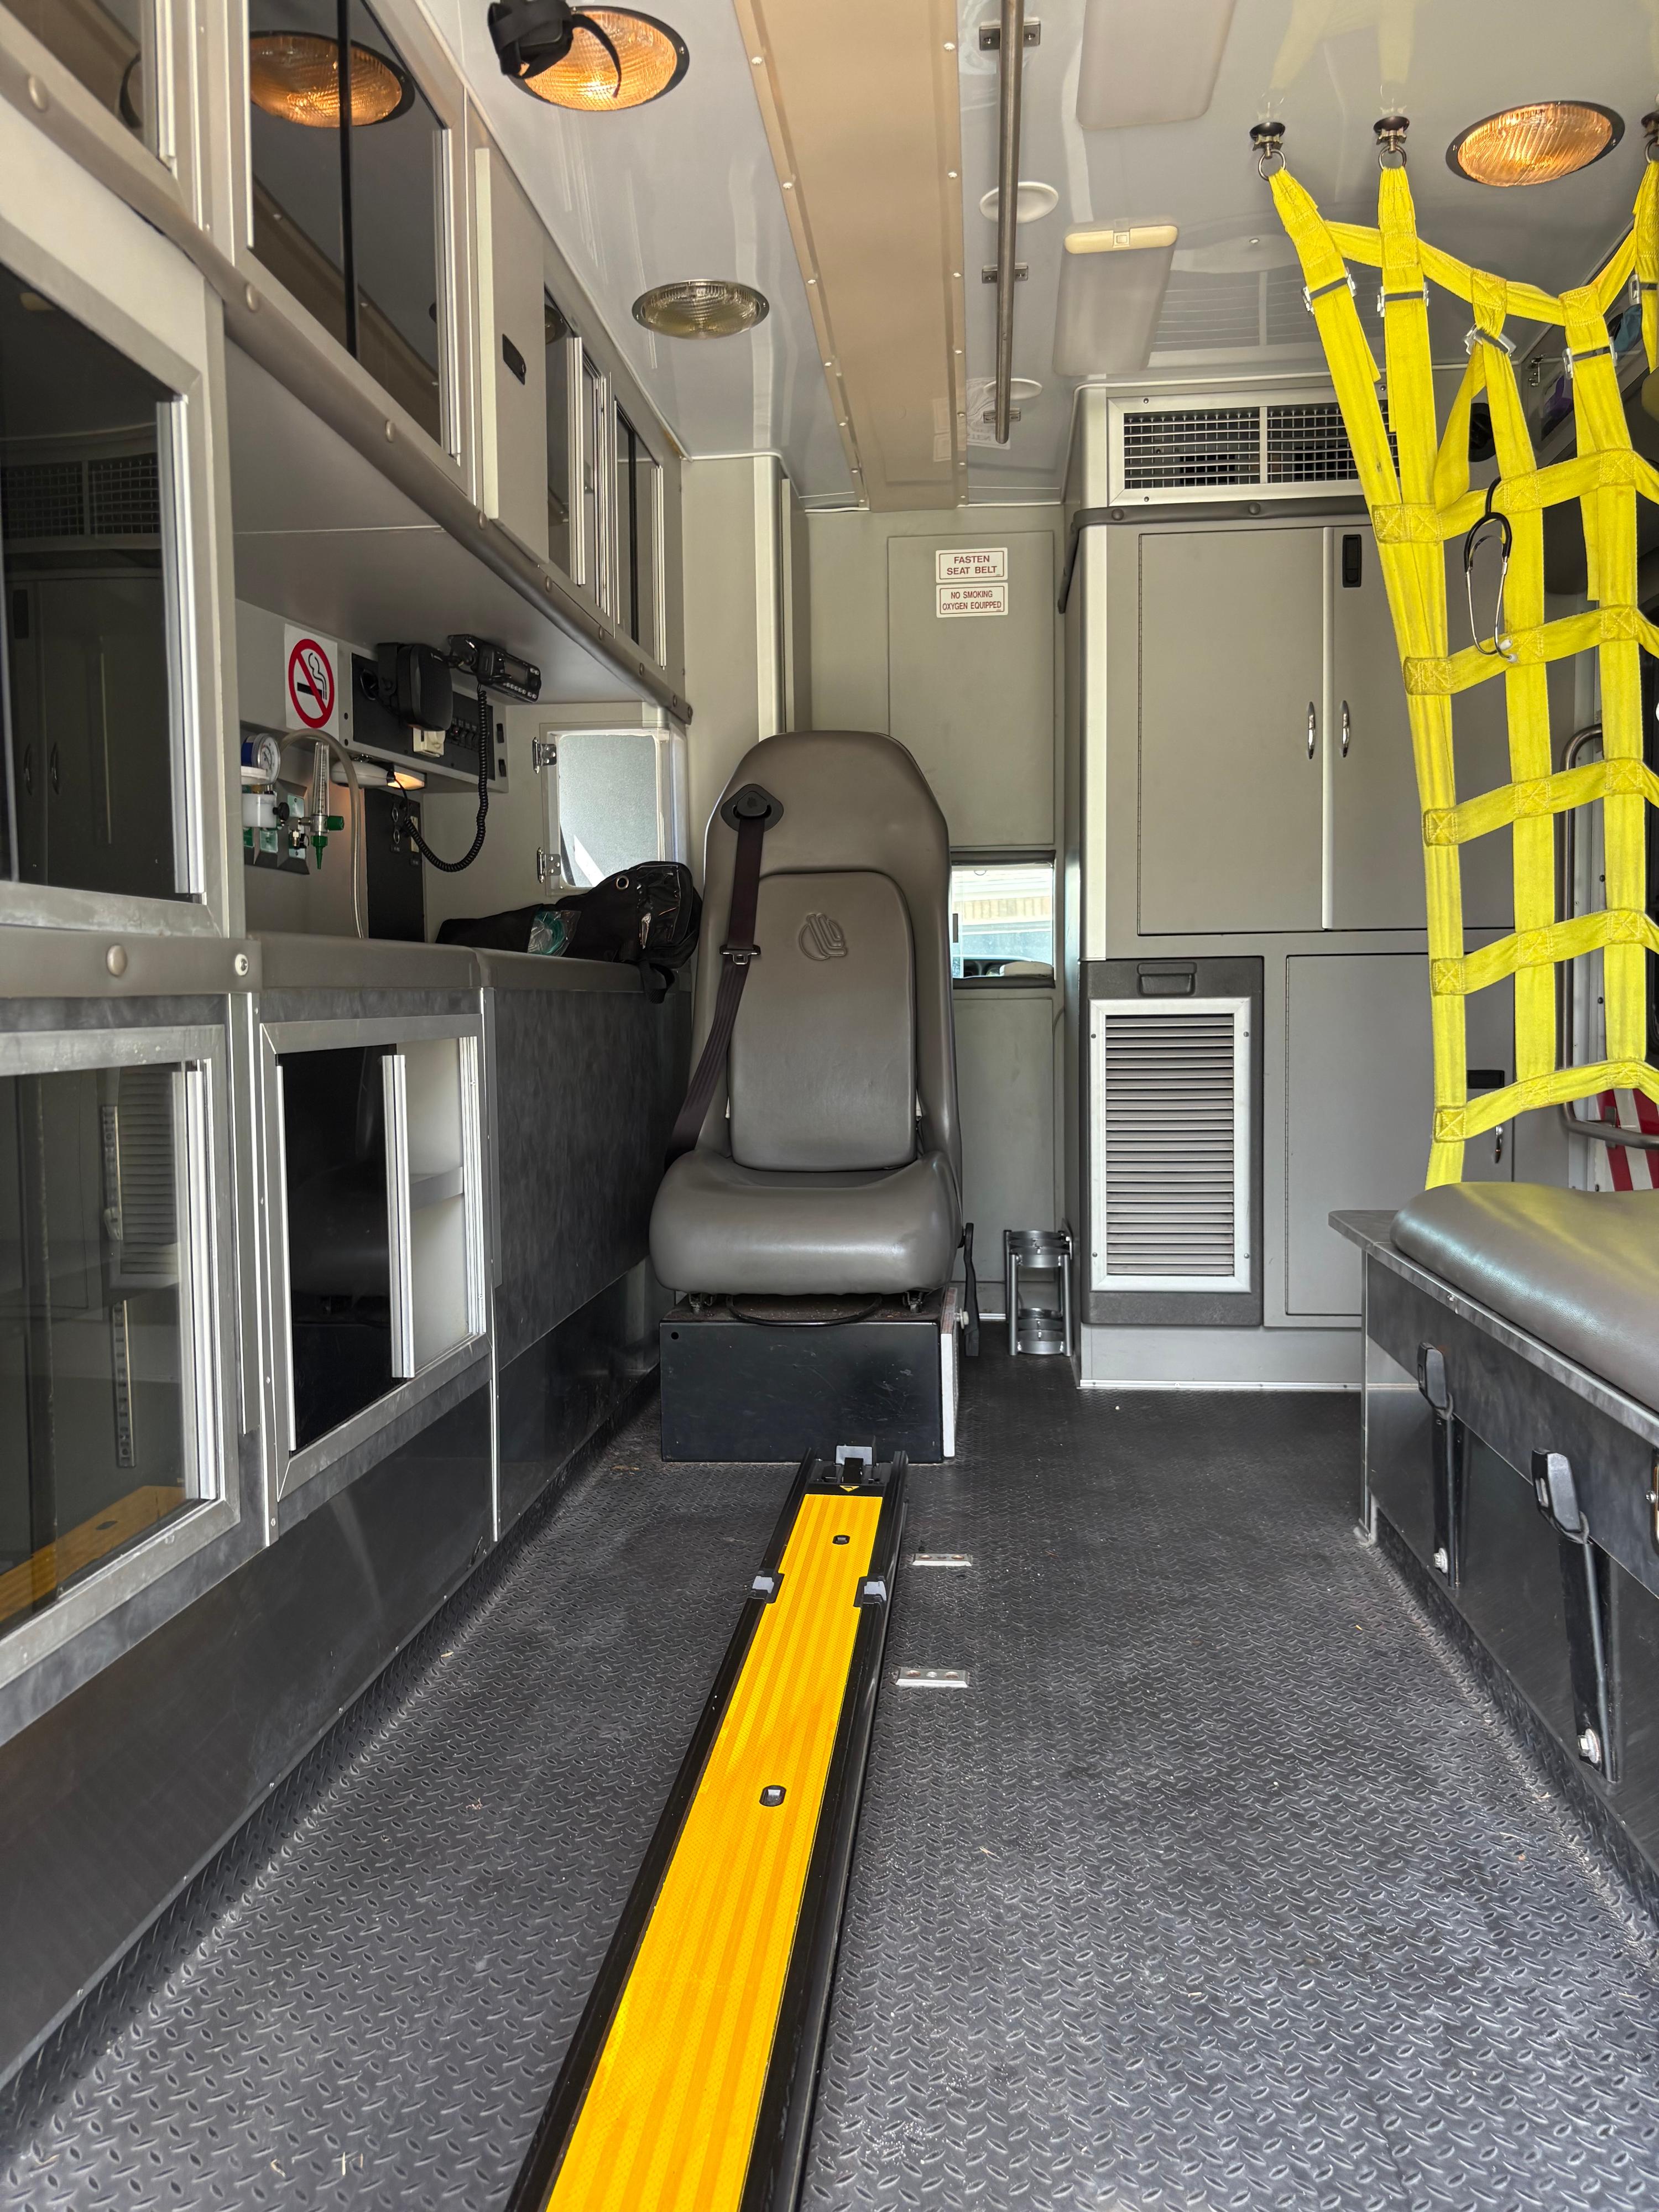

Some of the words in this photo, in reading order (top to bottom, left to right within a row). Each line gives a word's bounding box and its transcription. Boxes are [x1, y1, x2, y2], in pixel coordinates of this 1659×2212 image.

[954, 555, 990, 564] FASTEN
[947, 567, 971, 575] SEAT
[975, 566, 997, 574] BELT
[963, 590, 993, 599] SMOKING
[942, 602, 968, 611] OXYGEN
[971, 601, 1001, 609] EQUIPPED
